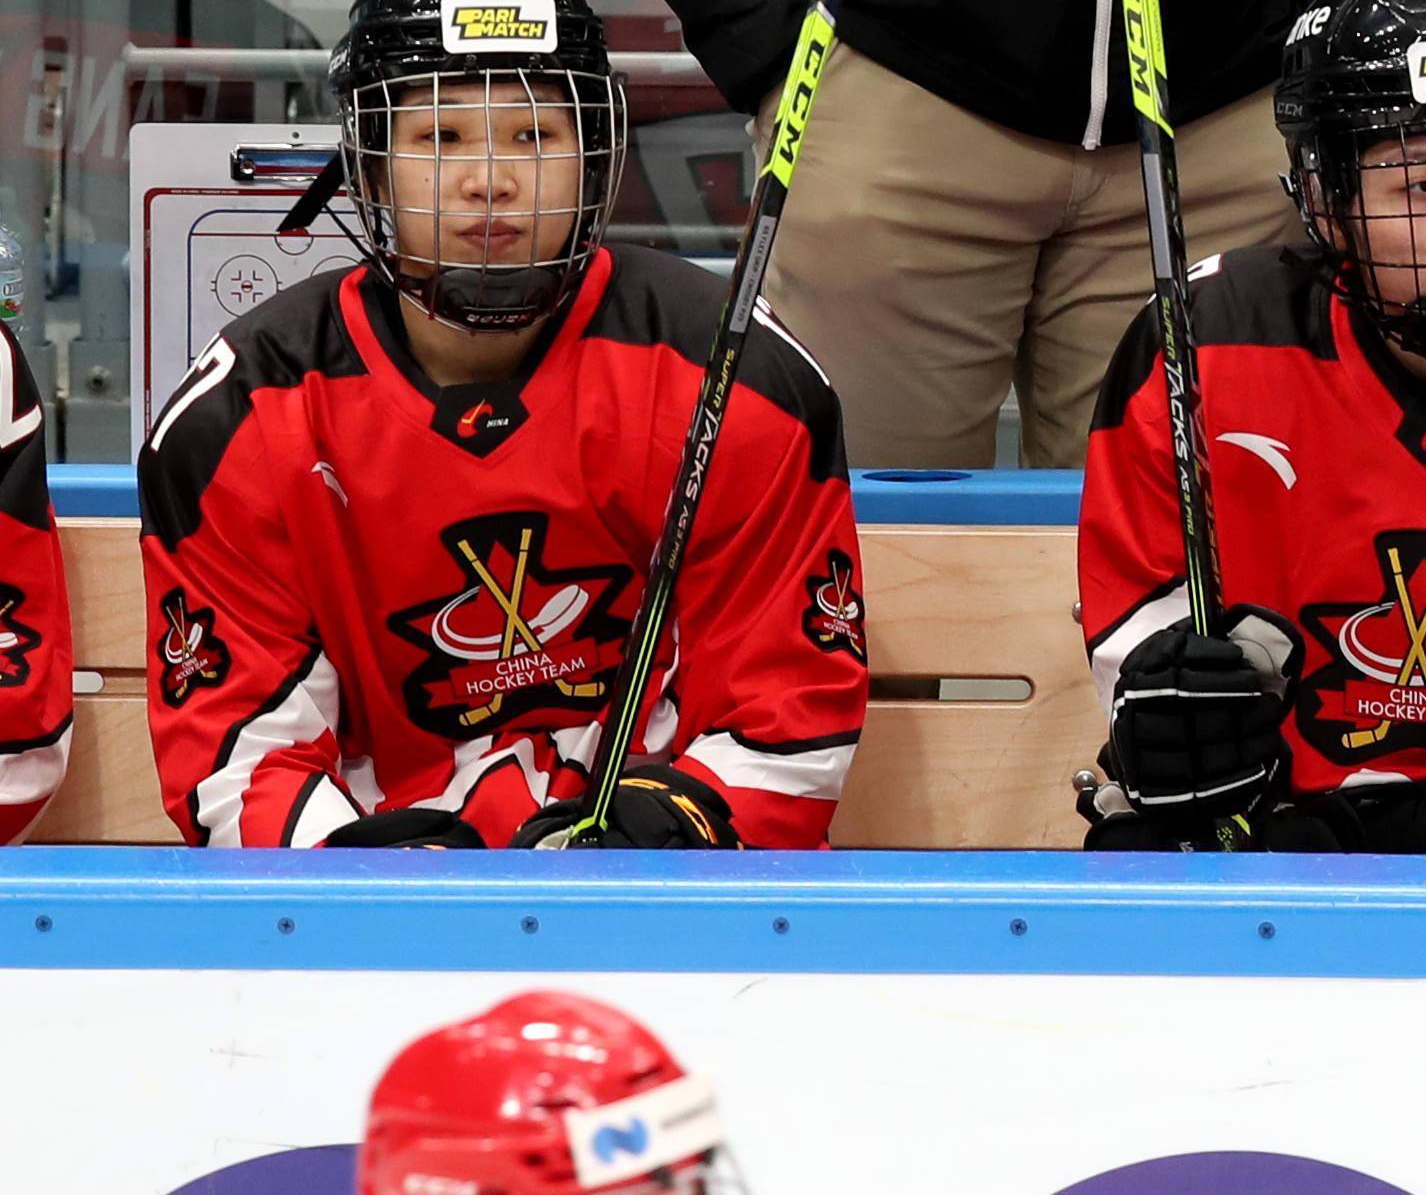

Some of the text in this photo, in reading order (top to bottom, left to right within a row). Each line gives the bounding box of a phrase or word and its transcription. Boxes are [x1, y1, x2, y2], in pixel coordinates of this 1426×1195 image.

[468, 8, 516, 24] PARI
[475, 22, 544, 38] MATCH
[779, 38, 826, 166] CCM
[1161, 296, 1177, 360] SUPER
[715, 348, 735, 408] SUPER
[1164, 361, 1191, 461] TACKS
[685, 405, 722, 502] TACKS
[466, 657, 586, 694] HOCKEY TEAM
[495, 653, 553, 676] CHINA
[1358, 700, 1426, 721] HOCKEY
